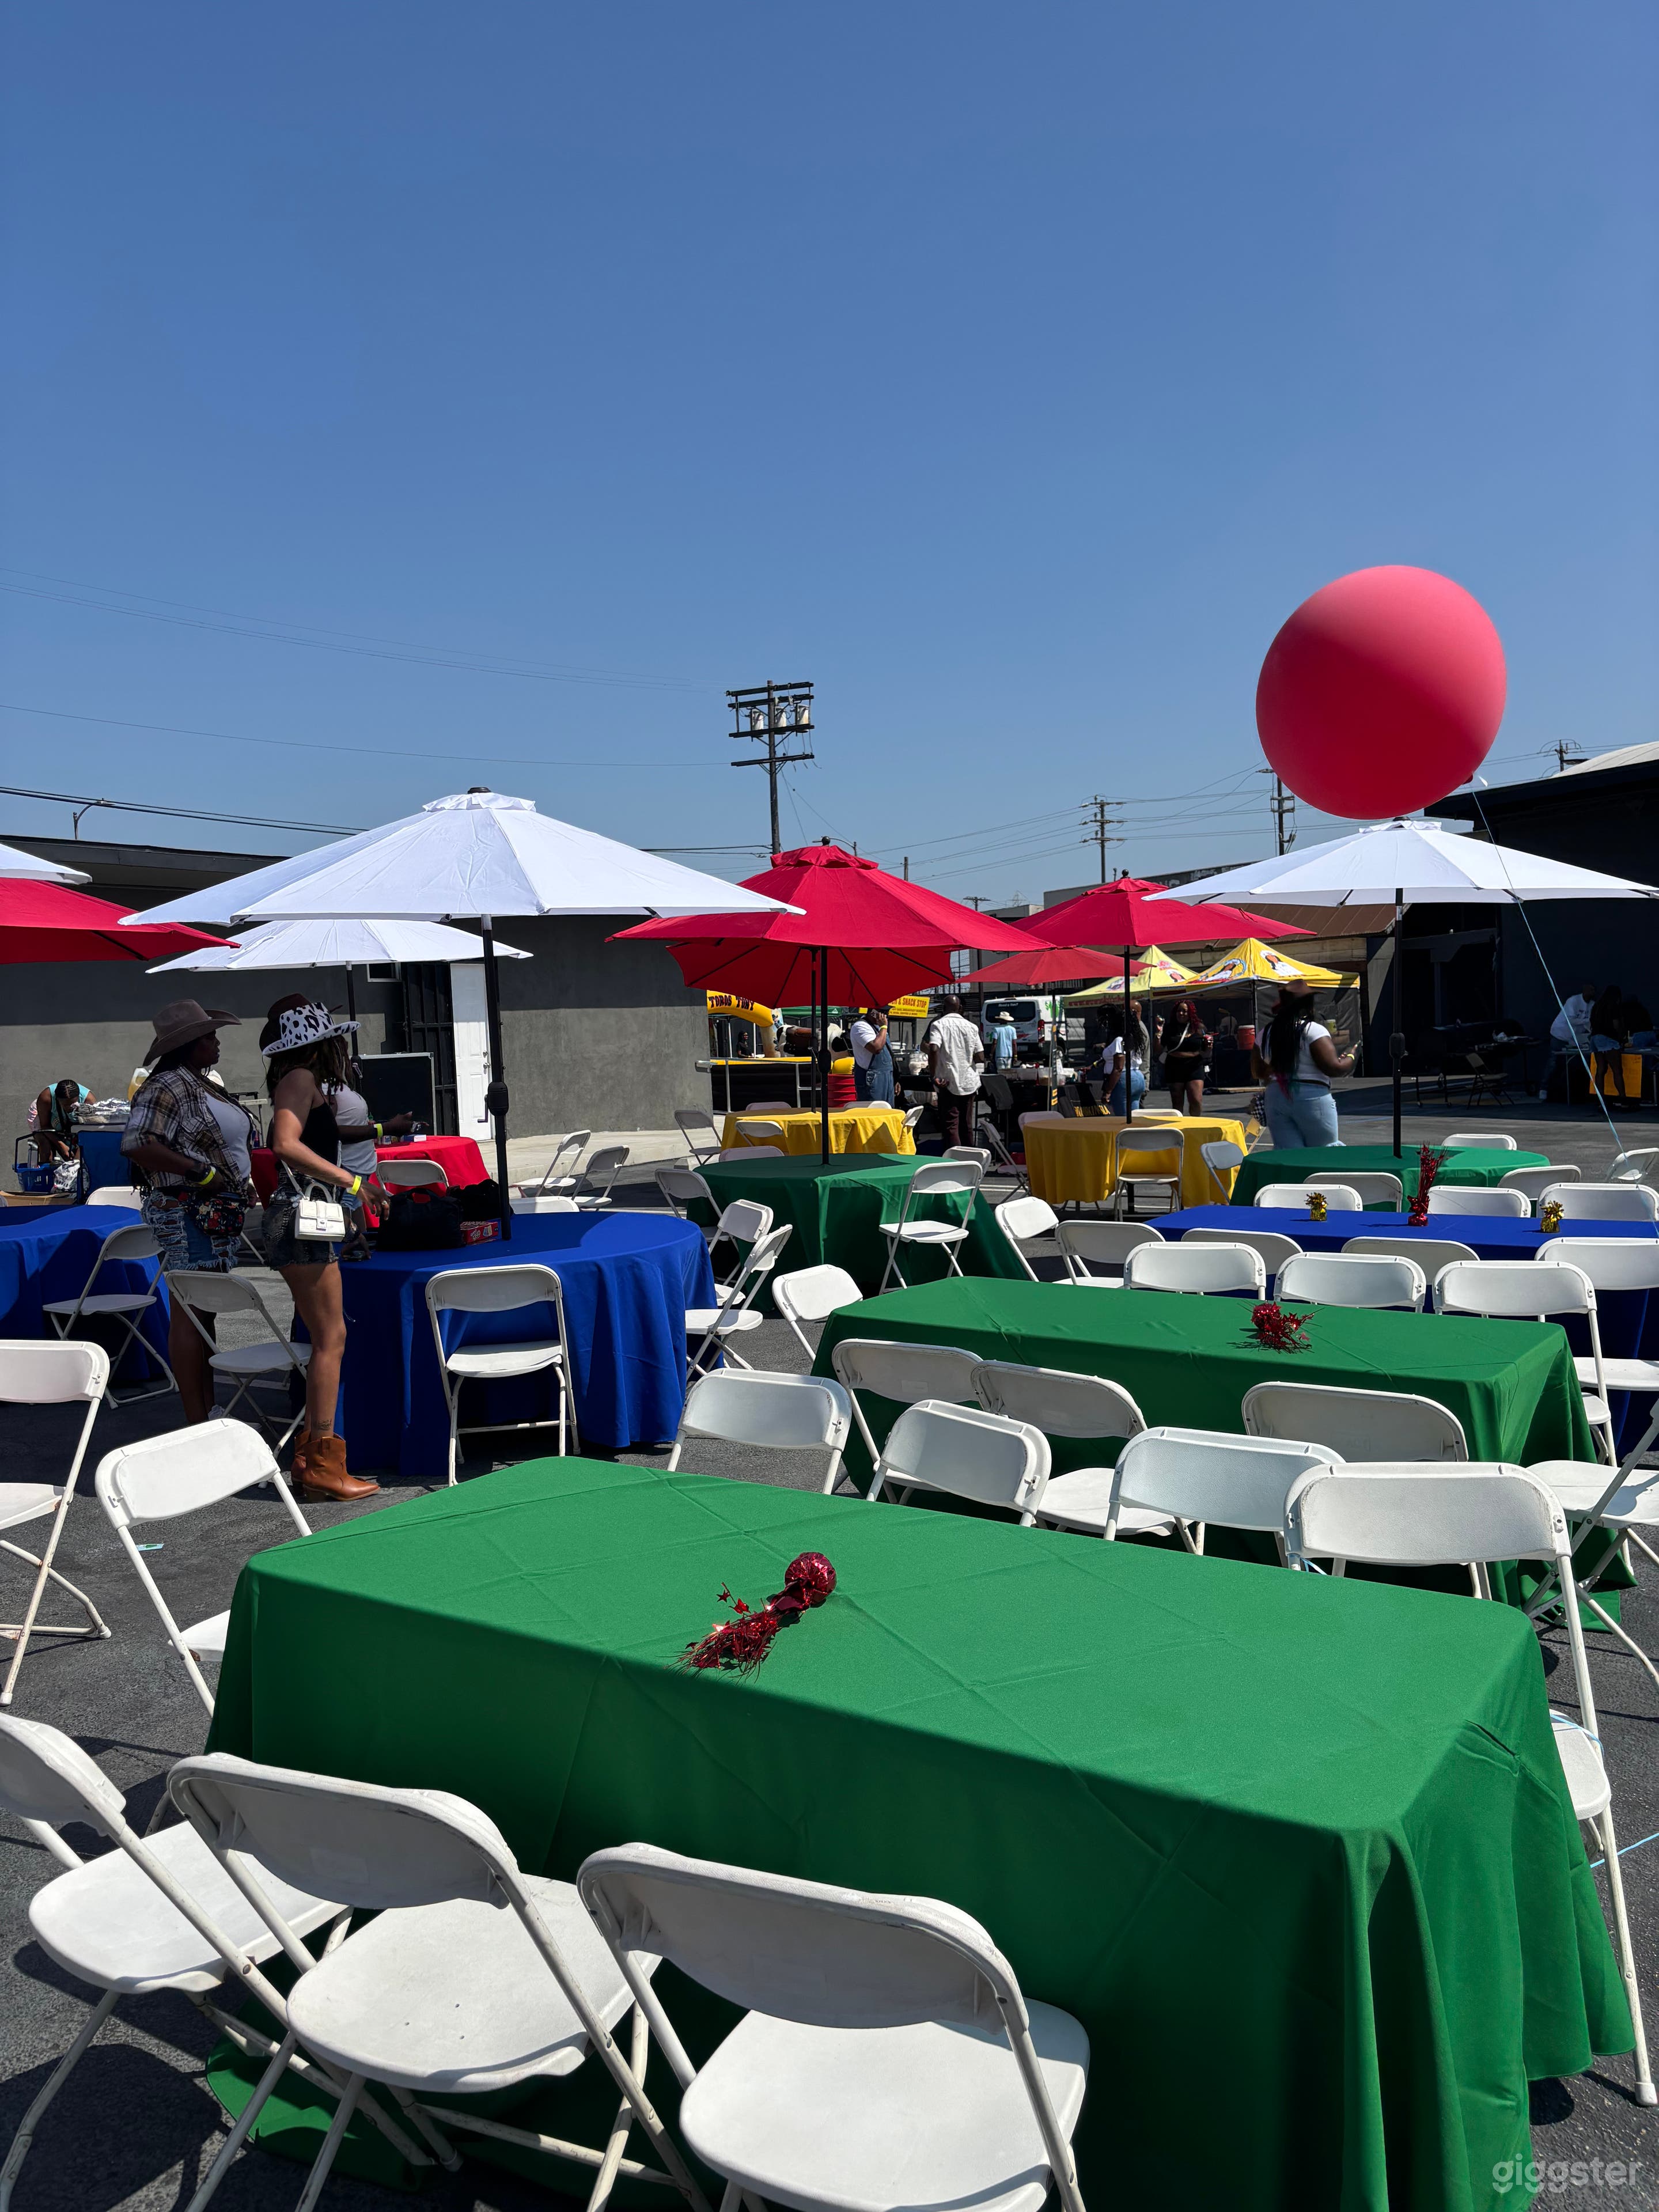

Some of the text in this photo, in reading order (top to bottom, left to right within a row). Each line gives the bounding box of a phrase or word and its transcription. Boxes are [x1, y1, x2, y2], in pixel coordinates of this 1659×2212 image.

[708, 995, 732, 1007] TOROS
[903, 998, 916, 1007] SNACK
[916, 1000, 927, 1008] STOP
